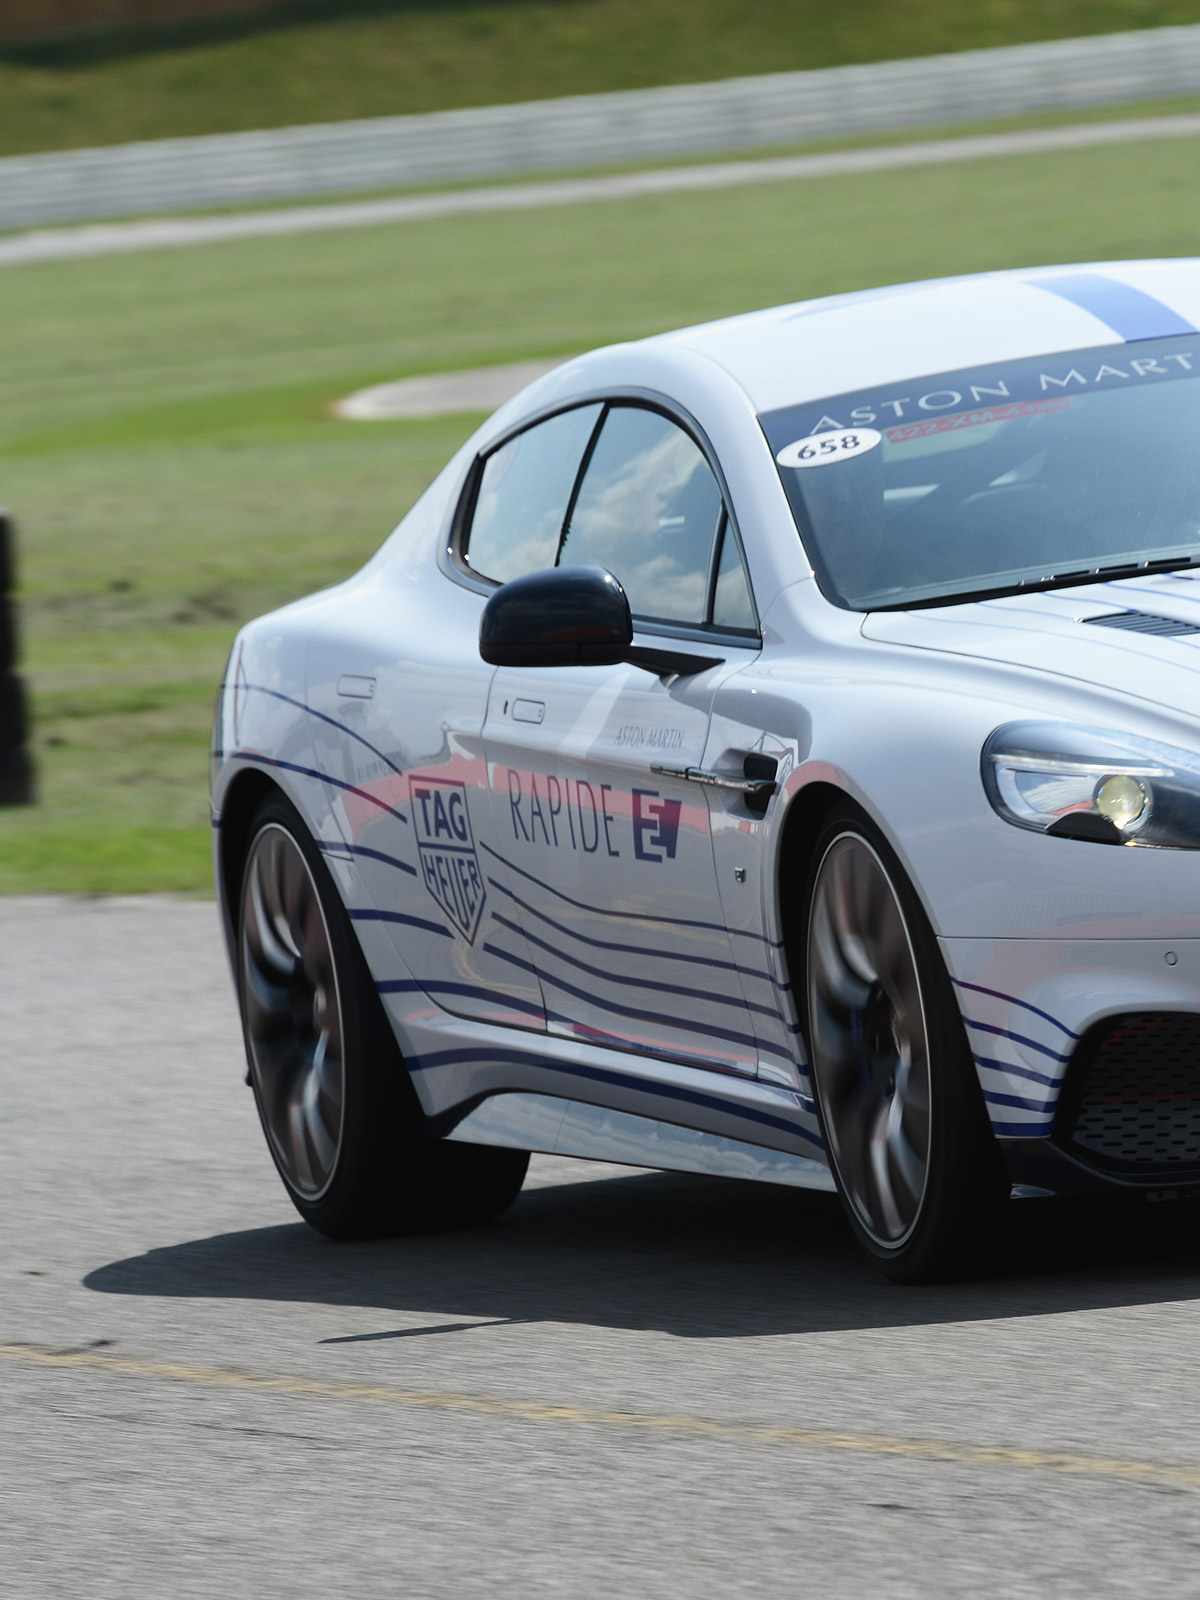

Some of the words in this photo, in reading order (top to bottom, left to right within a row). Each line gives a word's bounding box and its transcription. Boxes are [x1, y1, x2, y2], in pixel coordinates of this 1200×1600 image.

[810, 381, 1010, 435] ASTON
[797, 435, 861, 461] 658
[614, 726, 647, 747] ASTON
[646, 728, 685, 749] MARTIN
[415, 788, 468, 842] TAG
[507, 769, 620, 858] RAPIDE
[423, 853, 481, 933] HEUER
